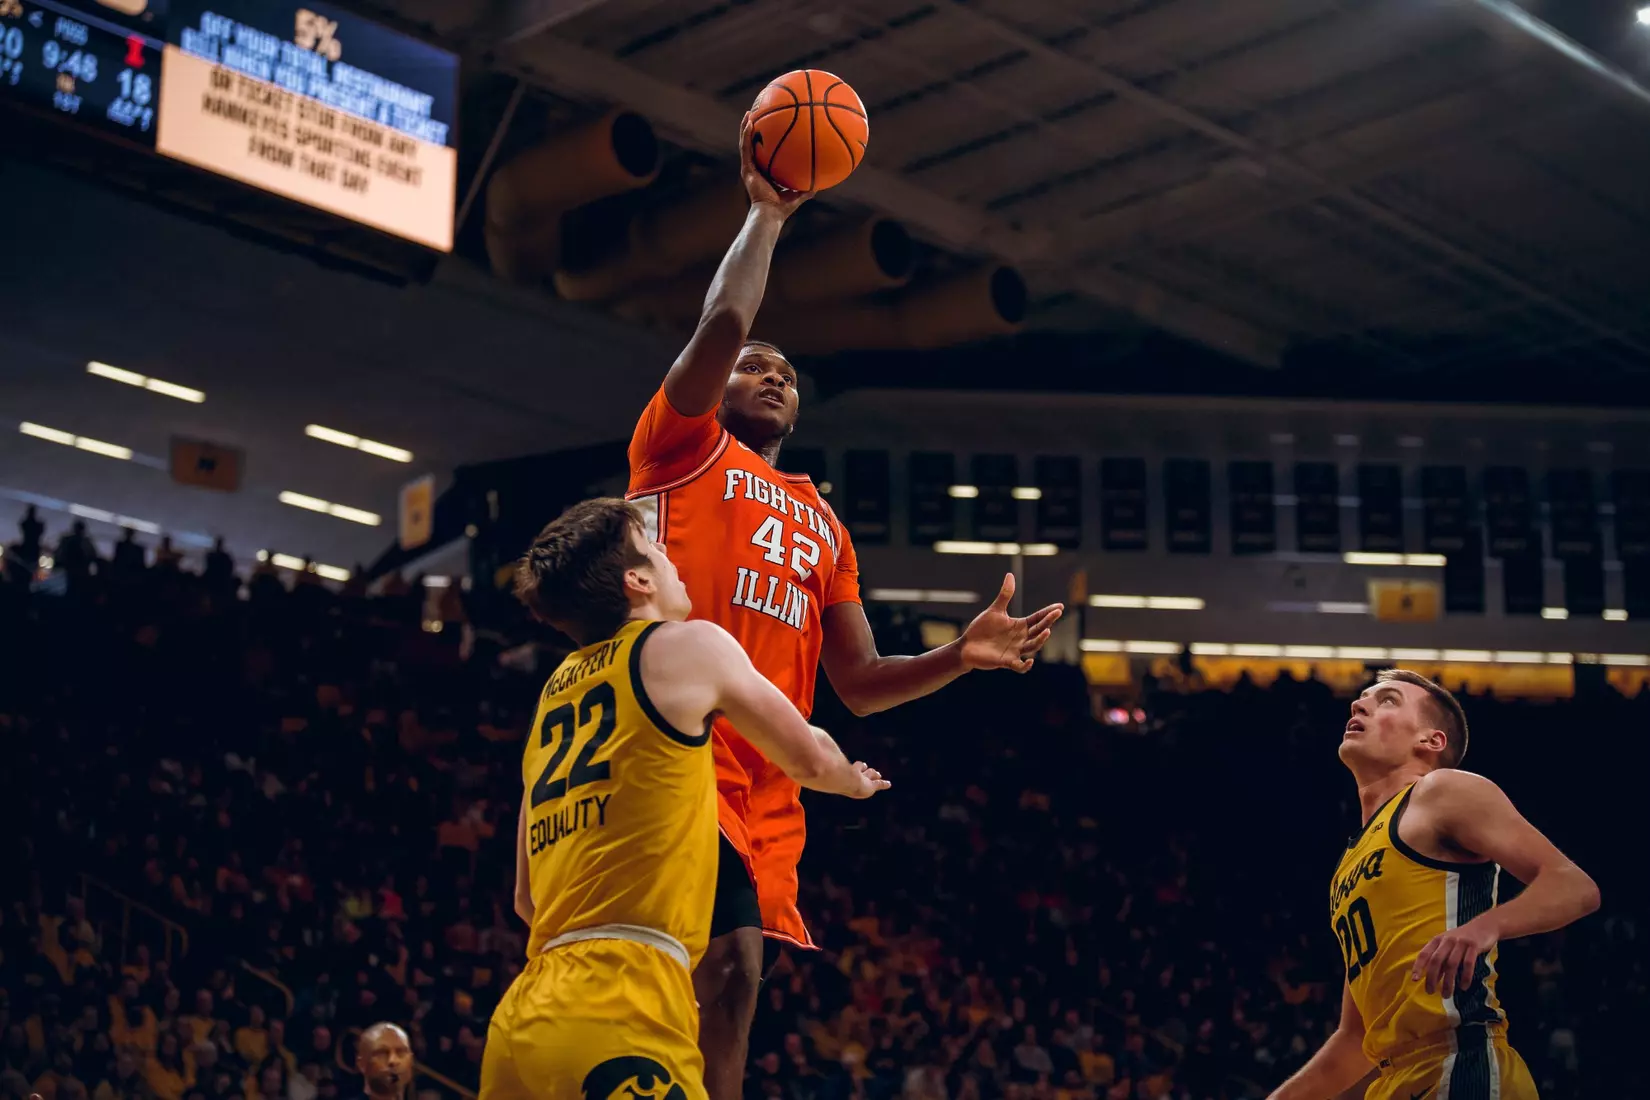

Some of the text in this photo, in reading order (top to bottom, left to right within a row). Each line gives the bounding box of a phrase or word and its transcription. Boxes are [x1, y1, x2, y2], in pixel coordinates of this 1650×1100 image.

[295, 9, 341, 61] 5%
[723, 468, 838, 560] FIGHTIN
[751, 514, 821, 582] 42
[731, 566, 809, 631] ILLINI
[531, 680, 616, 810] 22
[530, 793, 612, 857] EQUALITY
[1336, 896, 1378, 985] 20
